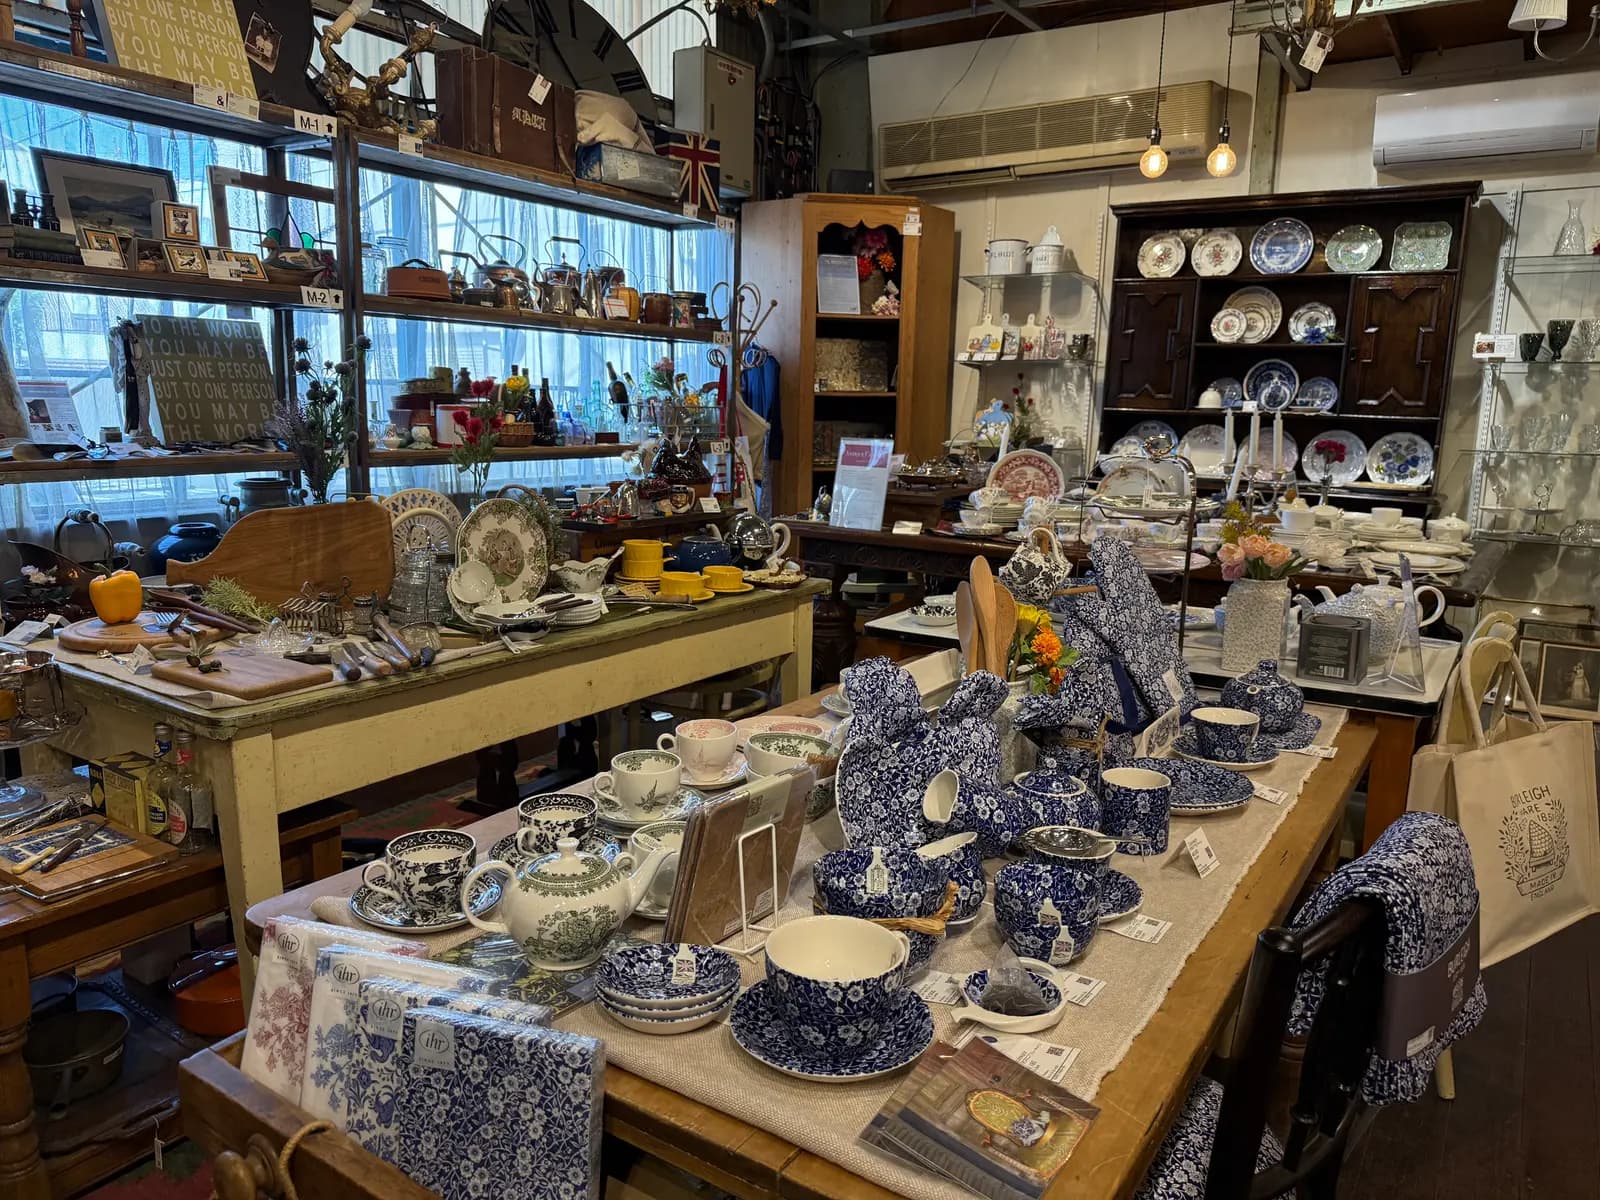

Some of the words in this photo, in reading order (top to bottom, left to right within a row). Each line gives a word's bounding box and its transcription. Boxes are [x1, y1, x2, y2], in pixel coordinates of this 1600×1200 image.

[146, 0, 177, 21] ONE
[106, 6, 136, 32] BUT
[140, 15, 161, 38] TO
[165, 23, 194, 47] ONE
[195, 31, 248, 62] PERSON
[112, 30, 161, 59] YOU
[173, 46, 215, 75] MAY
[227, 61, 252, 84] BE
[300, 115, 319, 131] M-1
[306, 290, 328, 303] M-2
[168, 318, 200, 336] THE
[204, 320, 261, 339] WORLD
[144, 337, 185, 357] YOU
[196, 340, 233, 359] MAY
[244, 342, 267, 360] BE
[150, 359, 183, 378] JUST
[188, 360, 216, 379] ONE
[154, 381, 179, 399] BUT
[183, 381, 201, 400] TO
[204, 382, 229, 400] ONE
[231, 382, 277, 401] PERSON
[160, 402, 201, 420] YOU
[211, 402, 249, 420] MAY
[164, 424, 203, 441] THE
[213, 423, 265, 441] WOR
[281, 934, 297, 950] ihr
[338, 964, 357, 981] ihr
[378, 1000, 398, 1018] ihr
[425, 1032, 446, 1050] ihr
